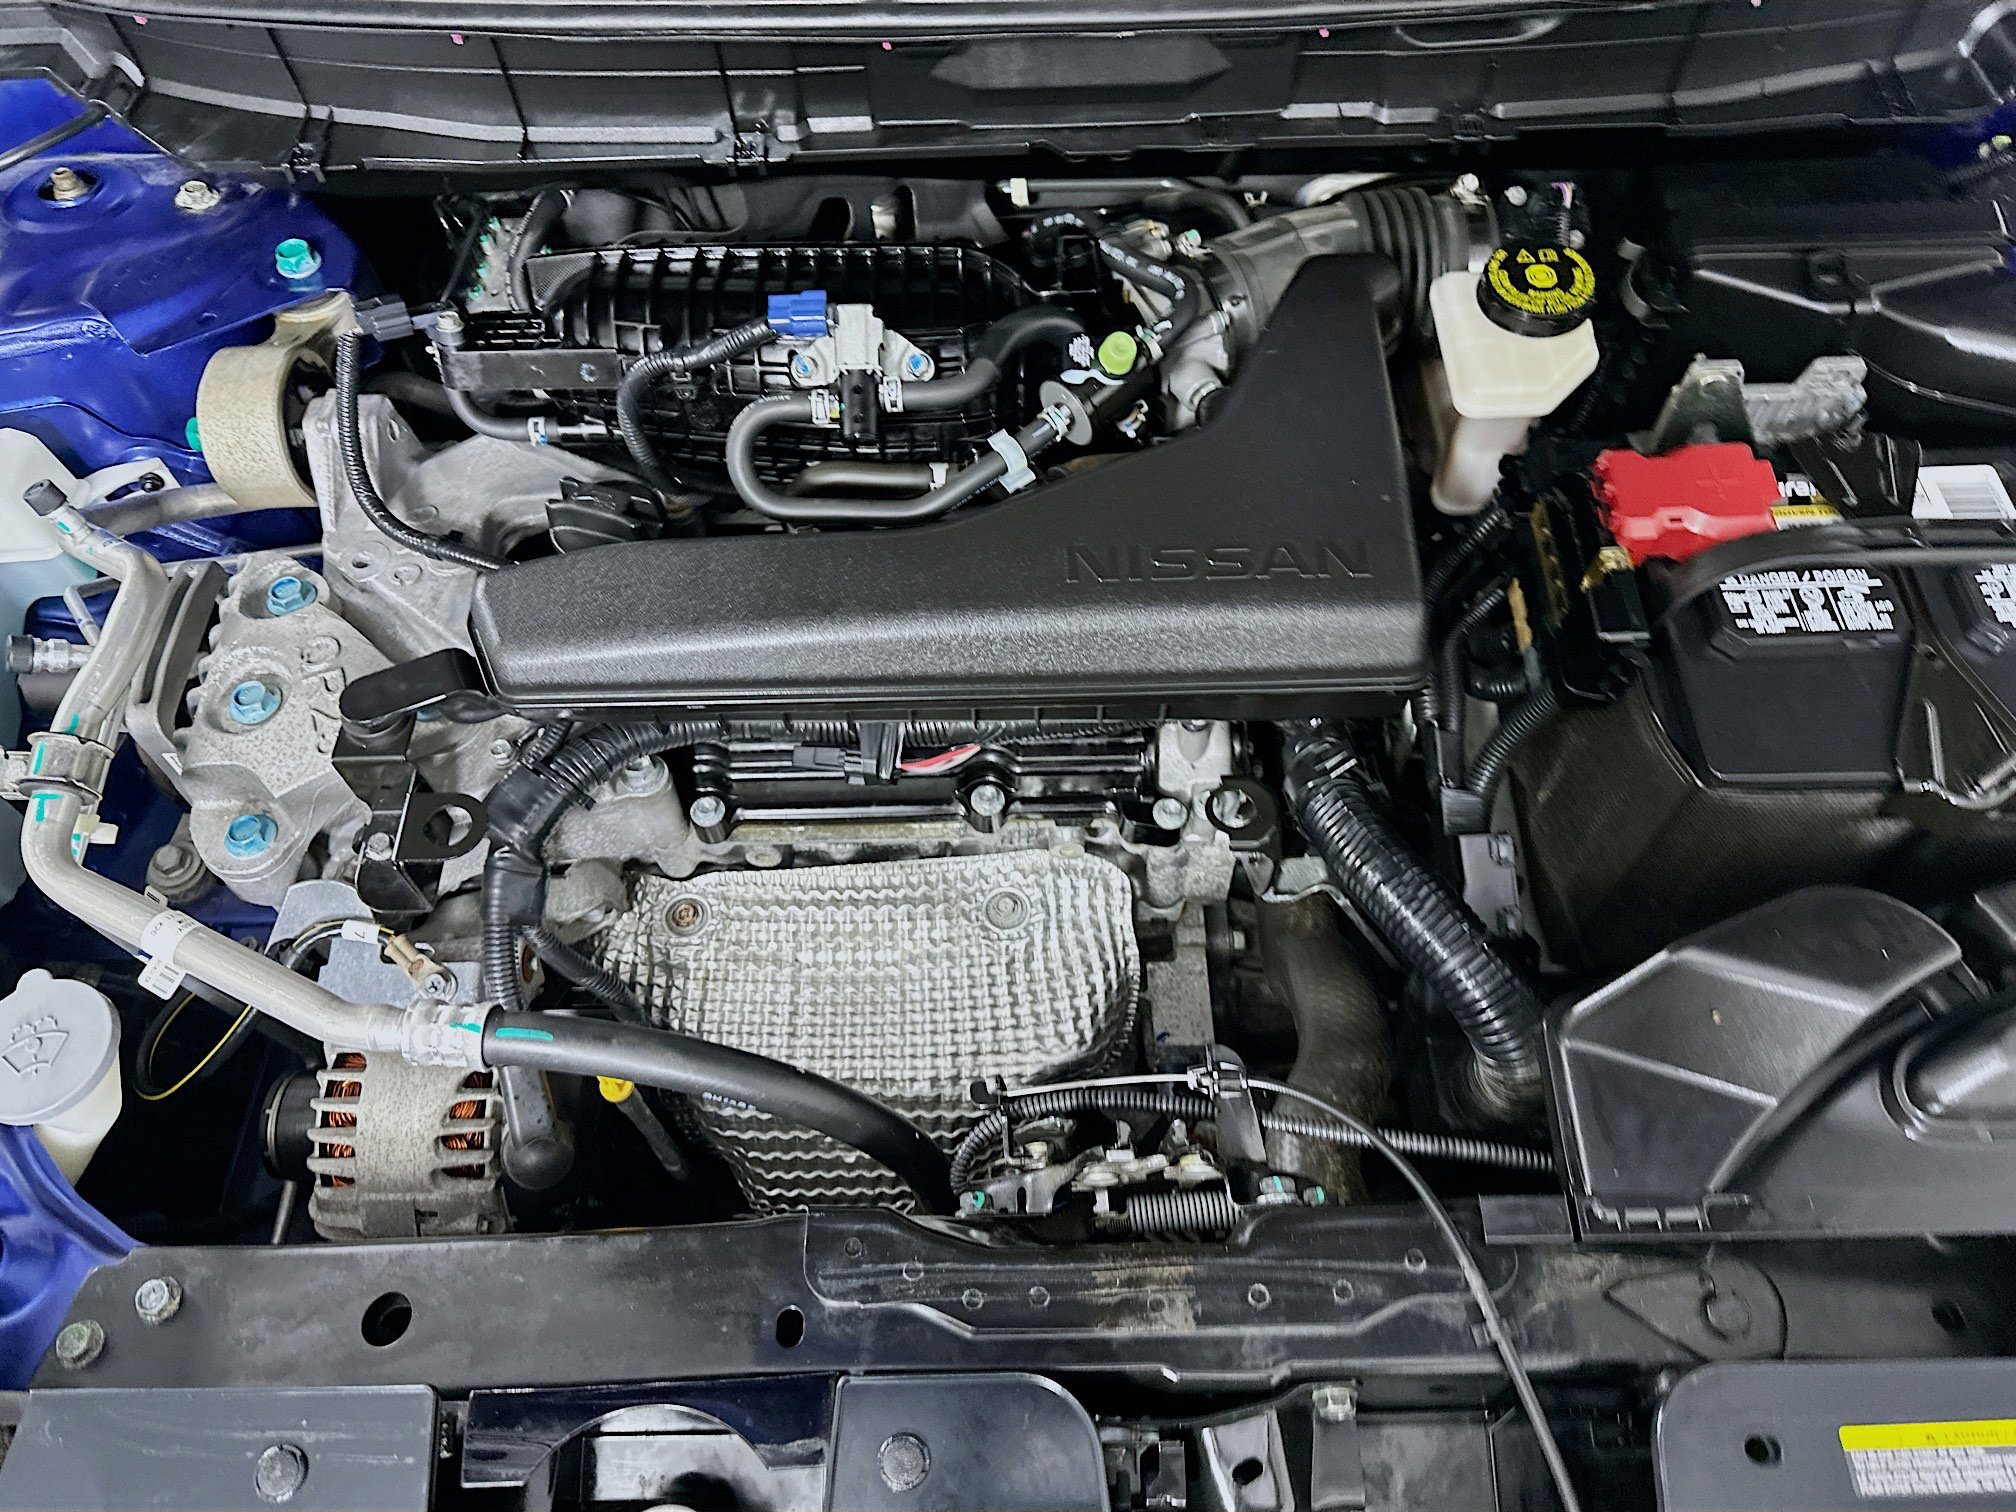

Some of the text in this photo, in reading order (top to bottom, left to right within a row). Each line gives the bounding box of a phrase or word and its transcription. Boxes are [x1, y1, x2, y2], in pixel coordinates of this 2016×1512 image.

[1065, 541, 1374, 582] NISSAN
[1738, 571, 1800, 586] DANGER
[1811, 568, 1871, 584] POISON
